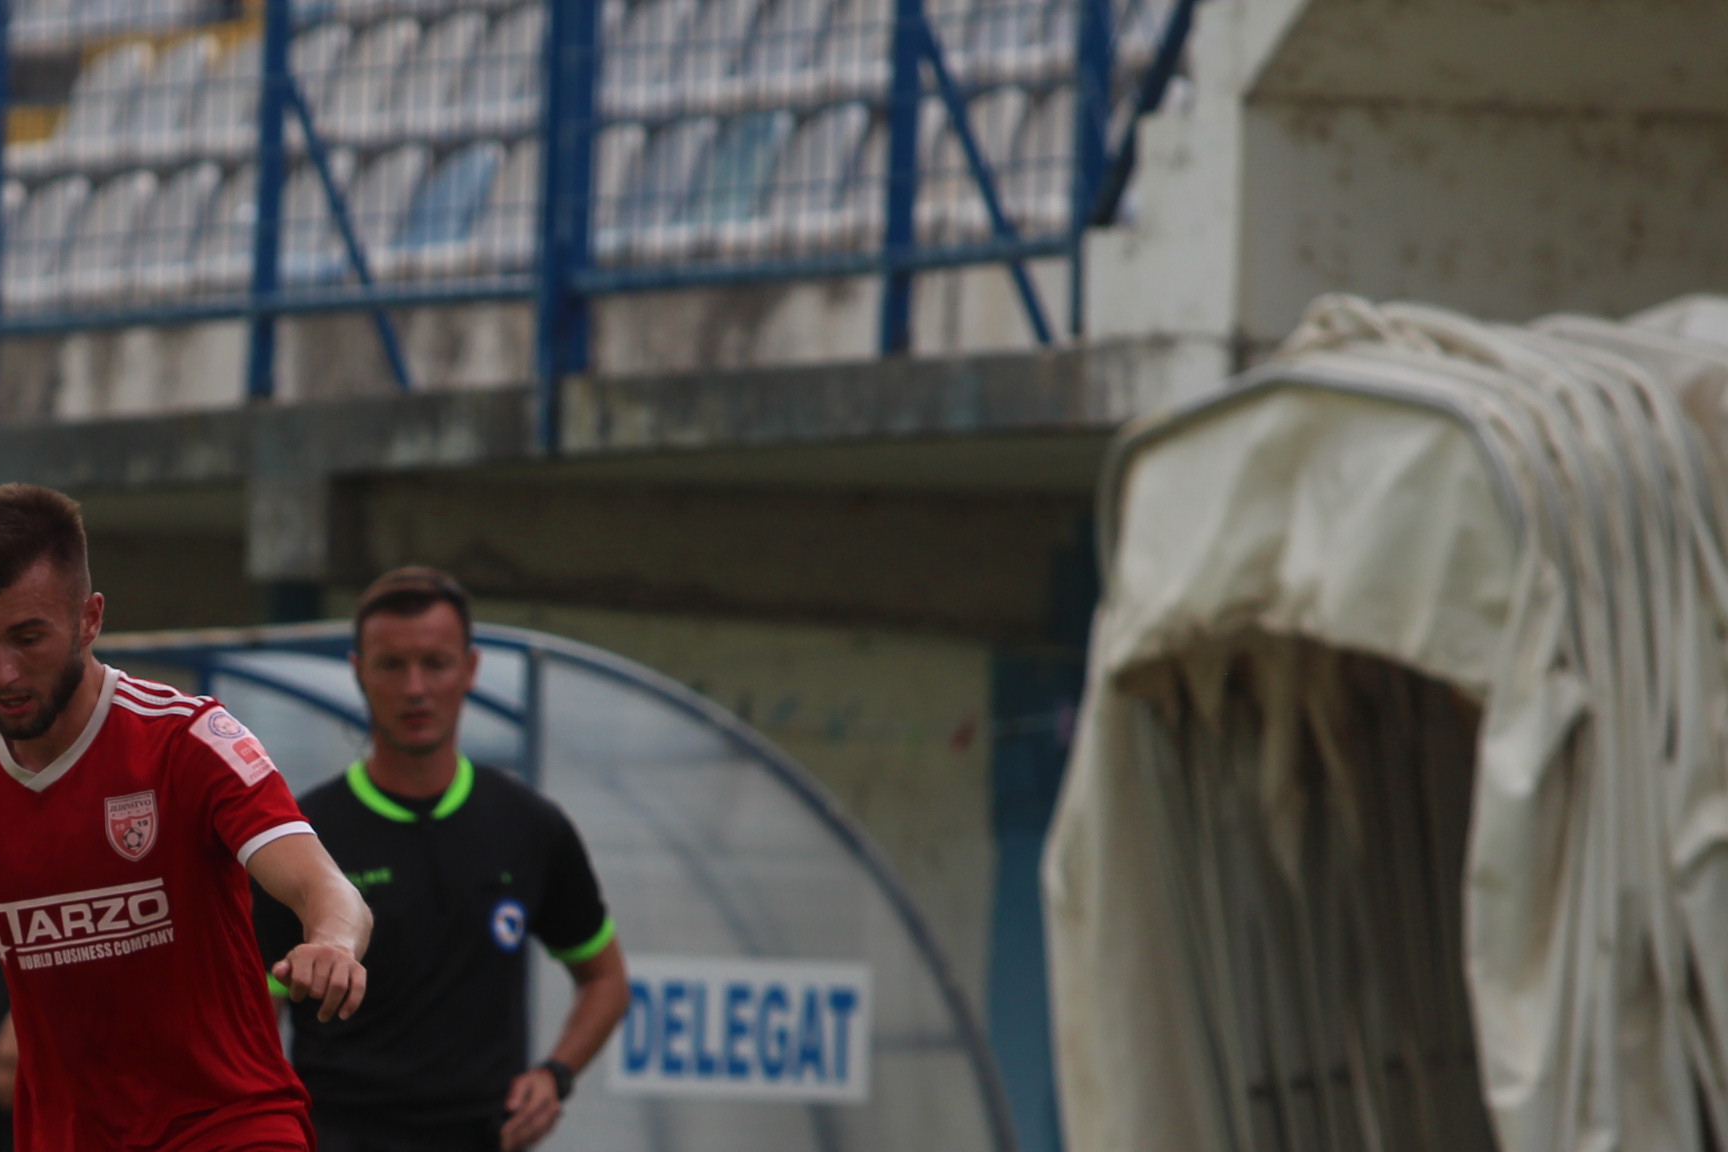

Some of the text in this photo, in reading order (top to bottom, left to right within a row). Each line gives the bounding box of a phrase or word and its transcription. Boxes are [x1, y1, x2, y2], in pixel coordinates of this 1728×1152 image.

[17, 927, 174, 970] WORLD BUSINESS COMPANY
[623, 980, 859, 1083] DELEGAT
